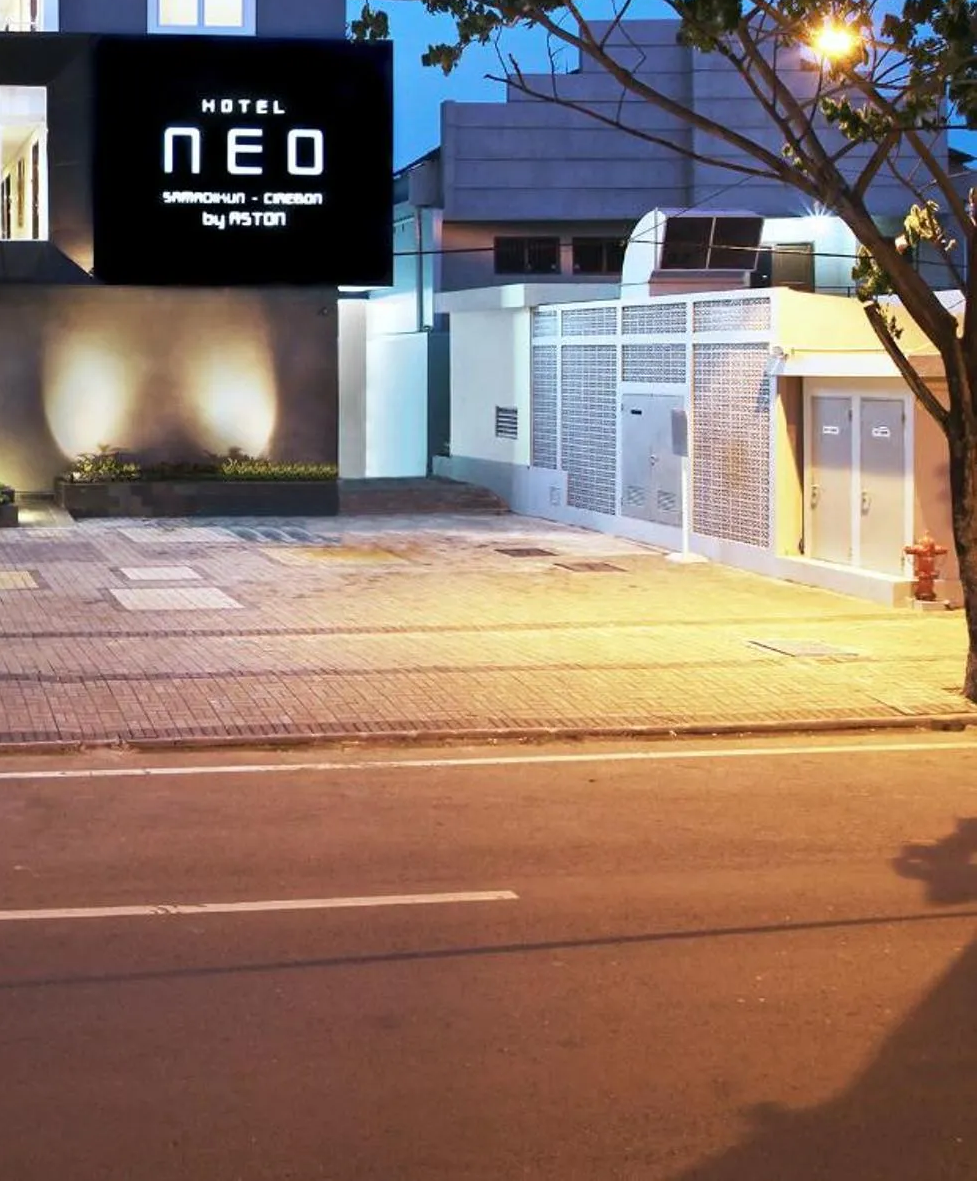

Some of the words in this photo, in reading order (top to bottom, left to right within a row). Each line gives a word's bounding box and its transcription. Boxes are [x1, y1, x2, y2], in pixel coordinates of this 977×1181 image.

[201, 98, 286, 115] HOTEL
[163, 127, 323, 175] NEO
[162, 191, 246, 204] SAMADIKUN
[263, 192, 323, 205] CIREBON
[202, 210, 226, 230] by
[229, 210, 287, 226] ASTON
